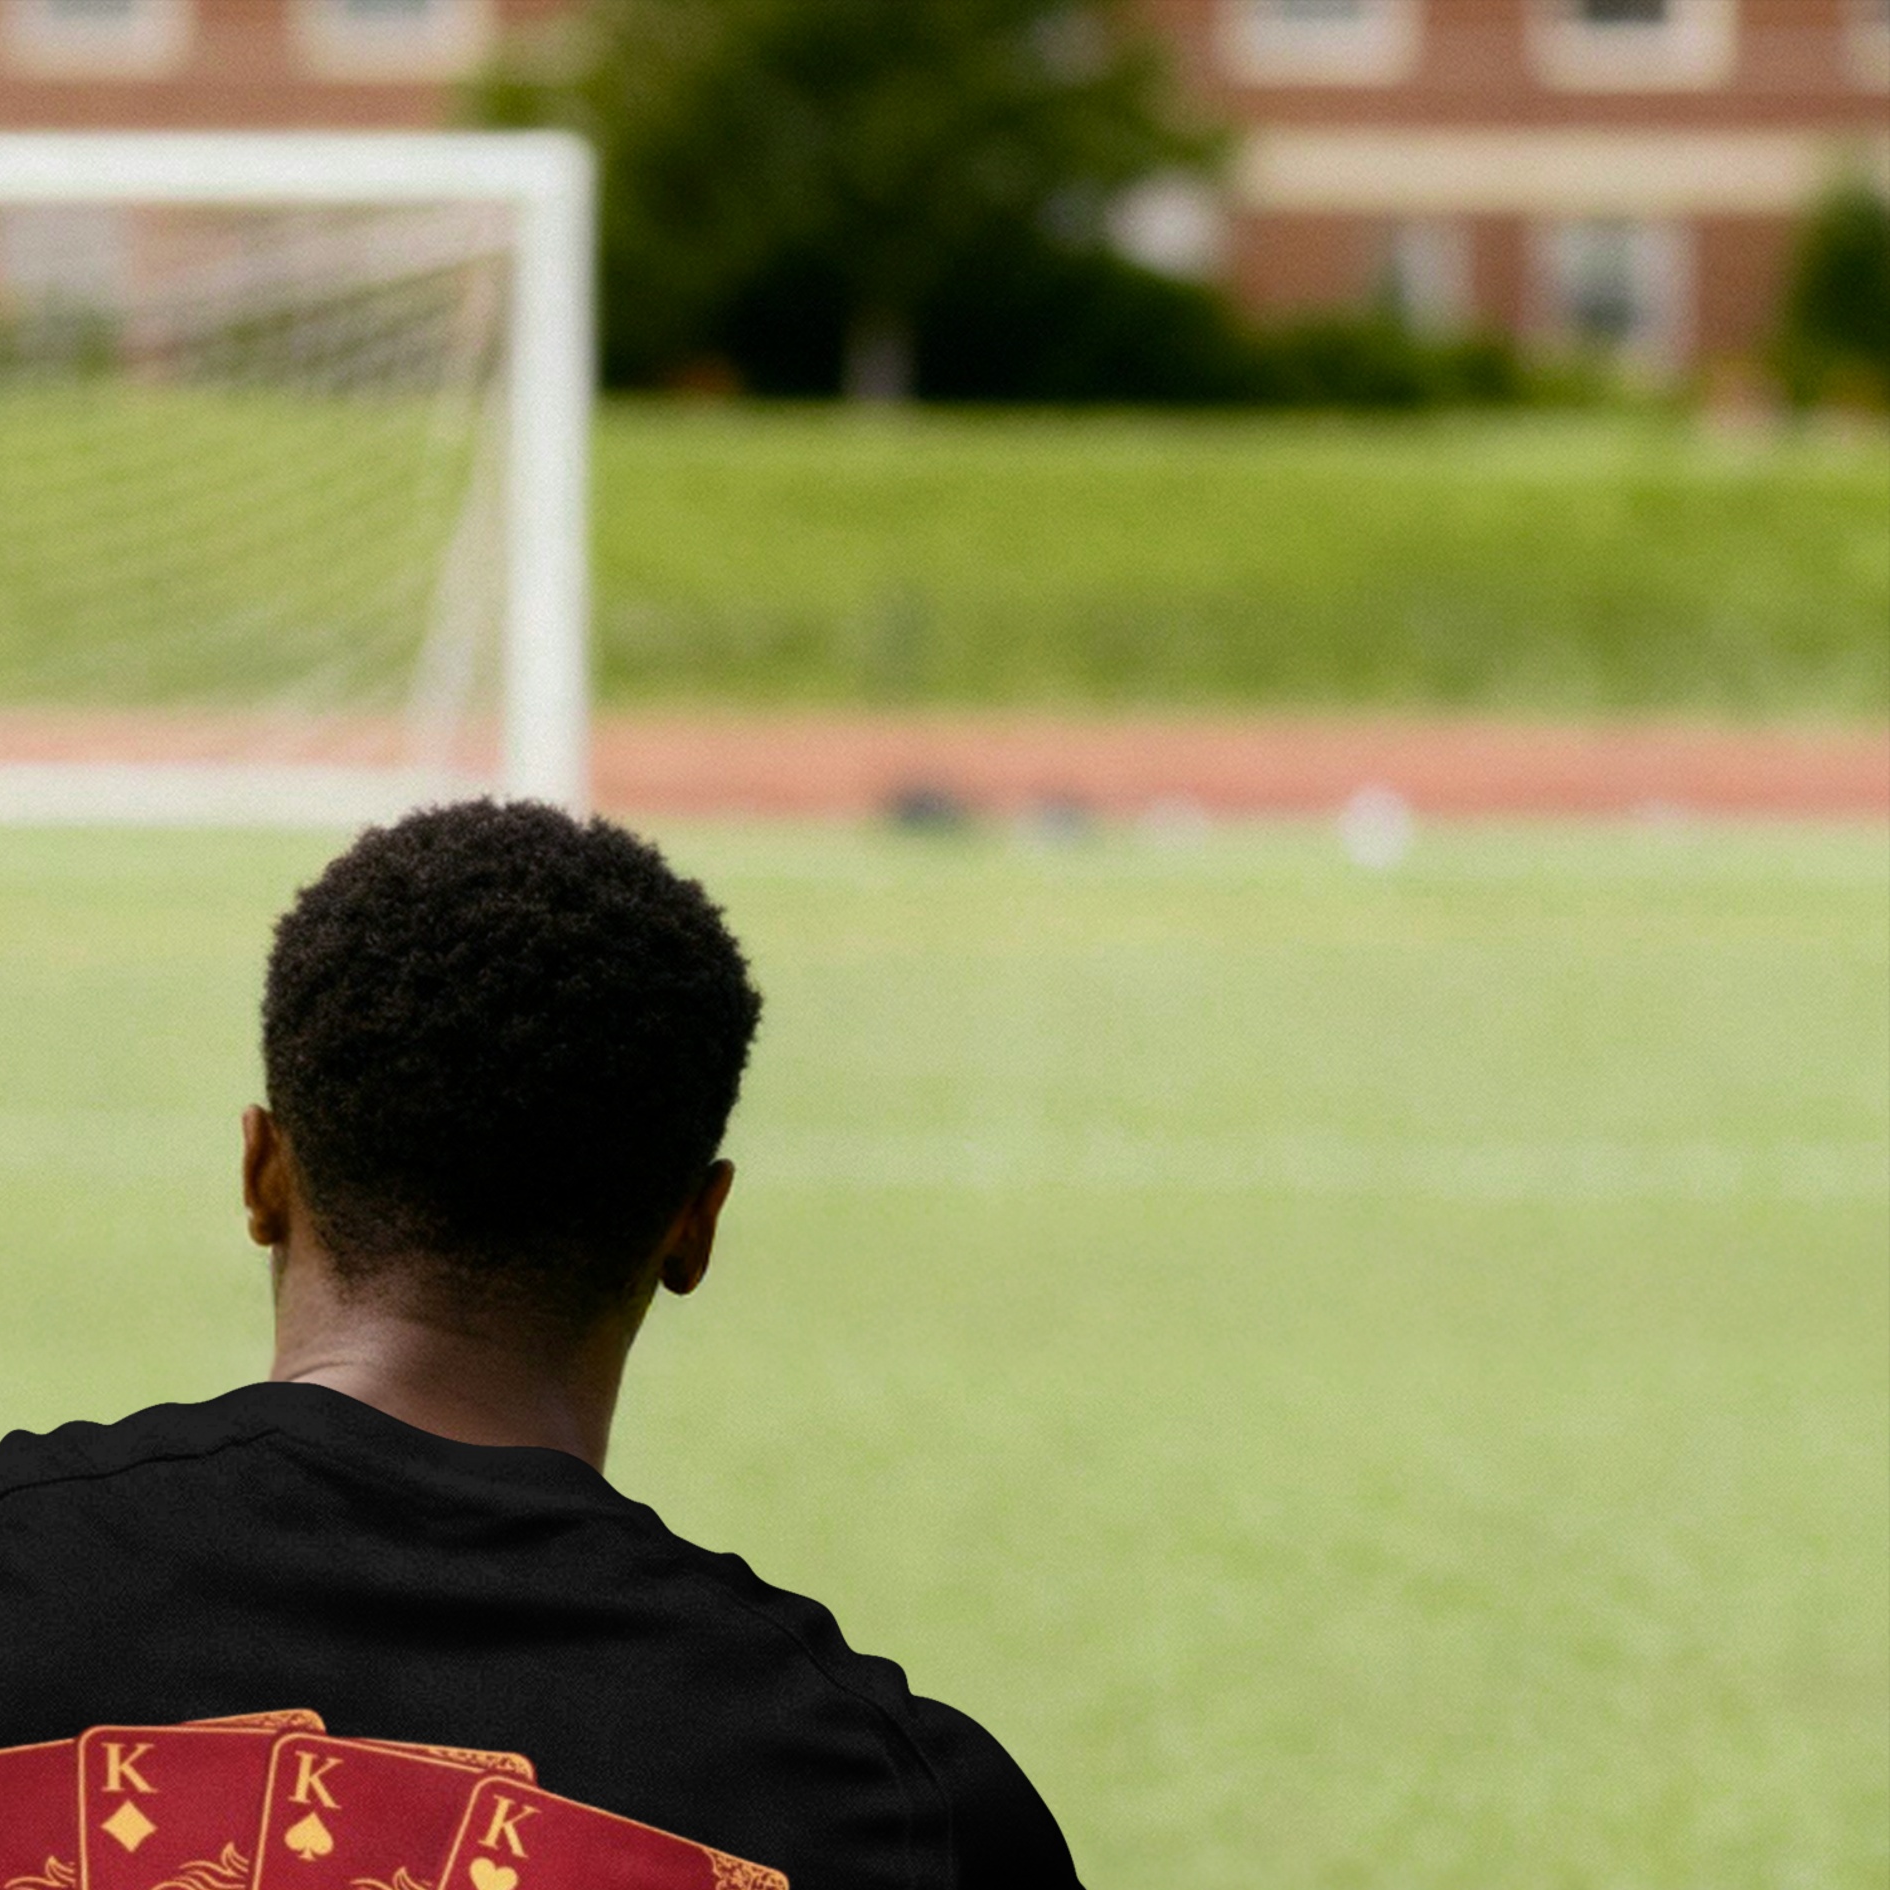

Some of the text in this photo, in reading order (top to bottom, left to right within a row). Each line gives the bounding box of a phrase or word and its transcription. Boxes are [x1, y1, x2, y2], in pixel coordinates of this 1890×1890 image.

[101, 1741, 158, 1794] K
[288, 1749, 343, 1810] K
[477, 1793, 542, 1859] K
